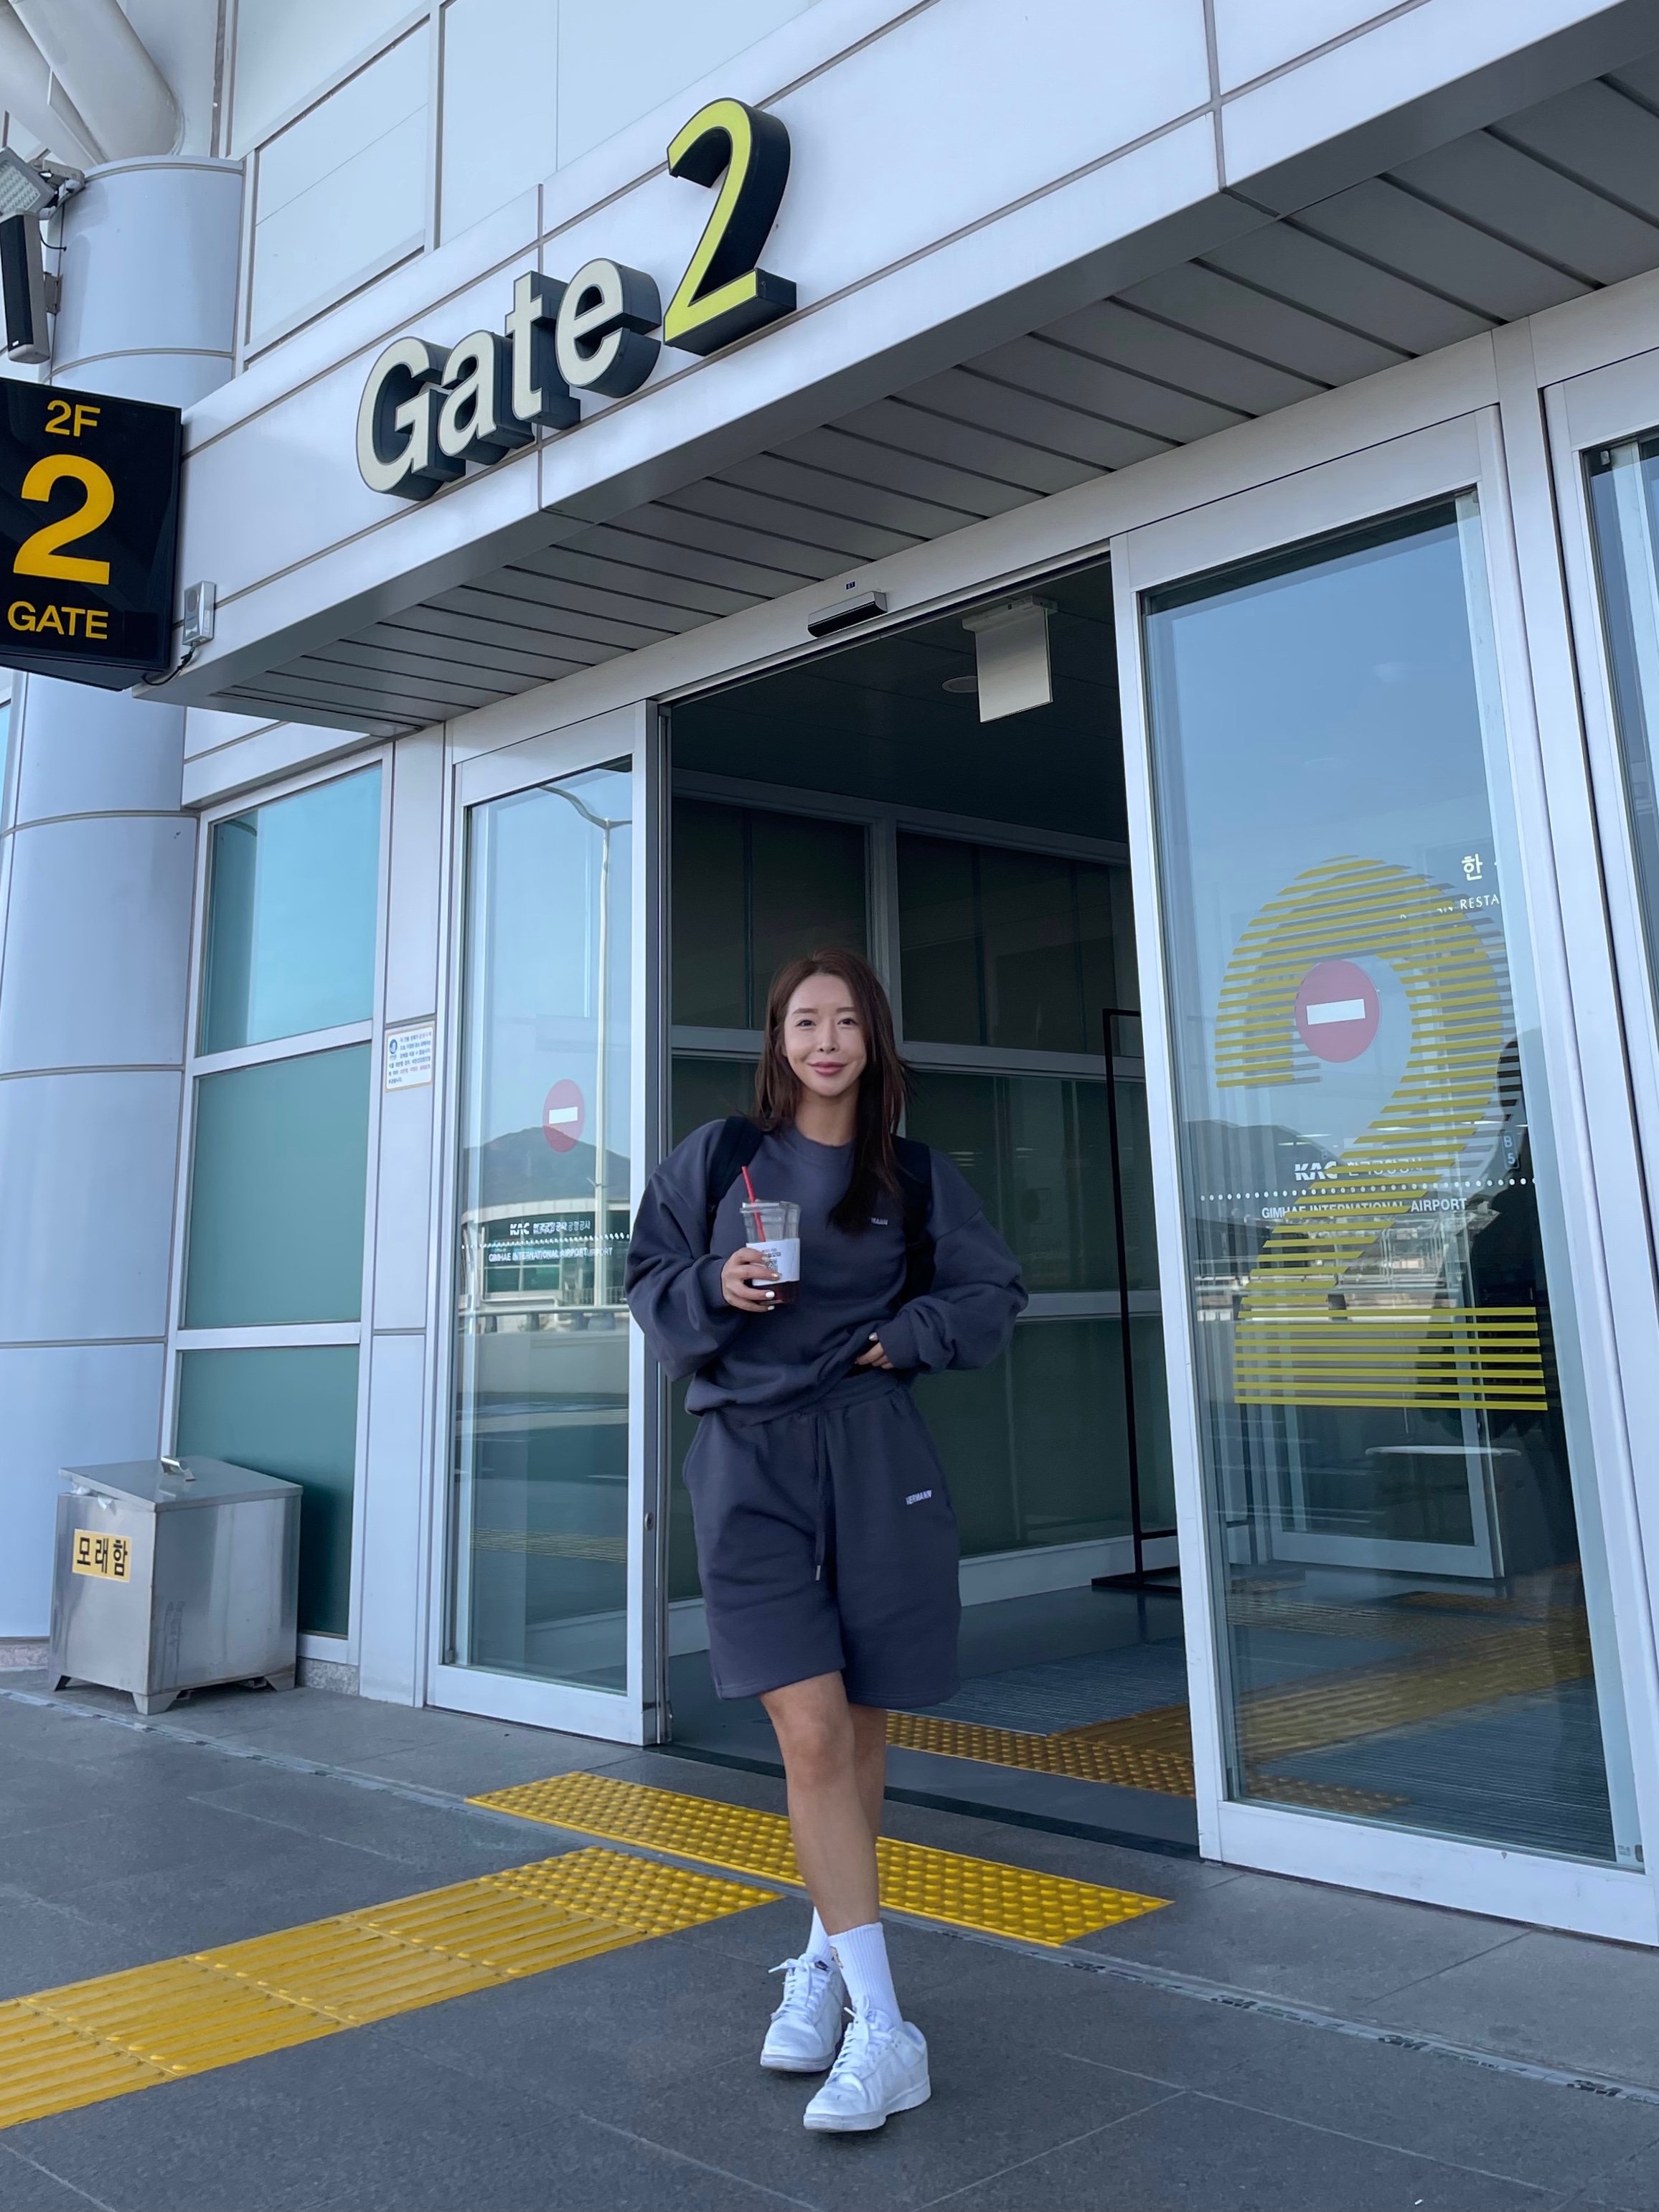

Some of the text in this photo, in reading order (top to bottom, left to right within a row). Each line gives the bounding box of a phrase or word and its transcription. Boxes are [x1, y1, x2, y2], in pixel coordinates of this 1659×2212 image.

[357, 98, 771, 498] Gate 2
[45, 400, 100, 437] 2F
[13, 453, 115, 585] 2
[7, 601, 109, 640] GATE
[1461, 853, 1498, 882] 한
[1507, 1152, 1515, 1164] 5
[1411, 1197, 1467, 1213] AIRPORT
[509, 1222, 530, 1236] KAC
[76, 1536, 128, 1576] 모래함
